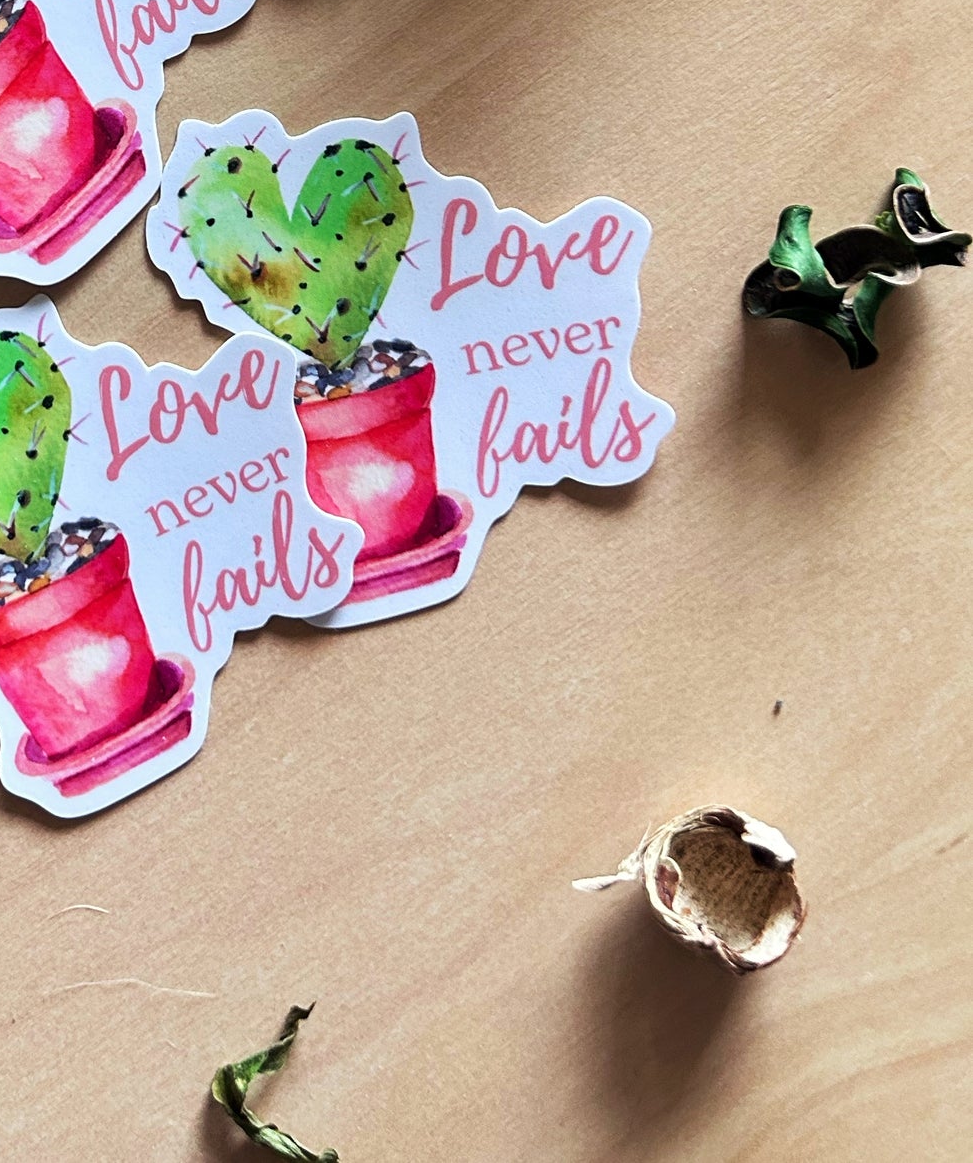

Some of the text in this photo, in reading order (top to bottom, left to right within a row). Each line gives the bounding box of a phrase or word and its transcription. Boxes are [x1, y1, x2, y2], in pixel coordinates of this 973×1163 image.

[430, 198, 634, 311] Love
[460, 316, 621, 375] never
[99, 349, 281, 481] Love
[476, 357, 656, 498] fails
[145, 447, 291, 537] never
[182, 489, 345, 653] fails
